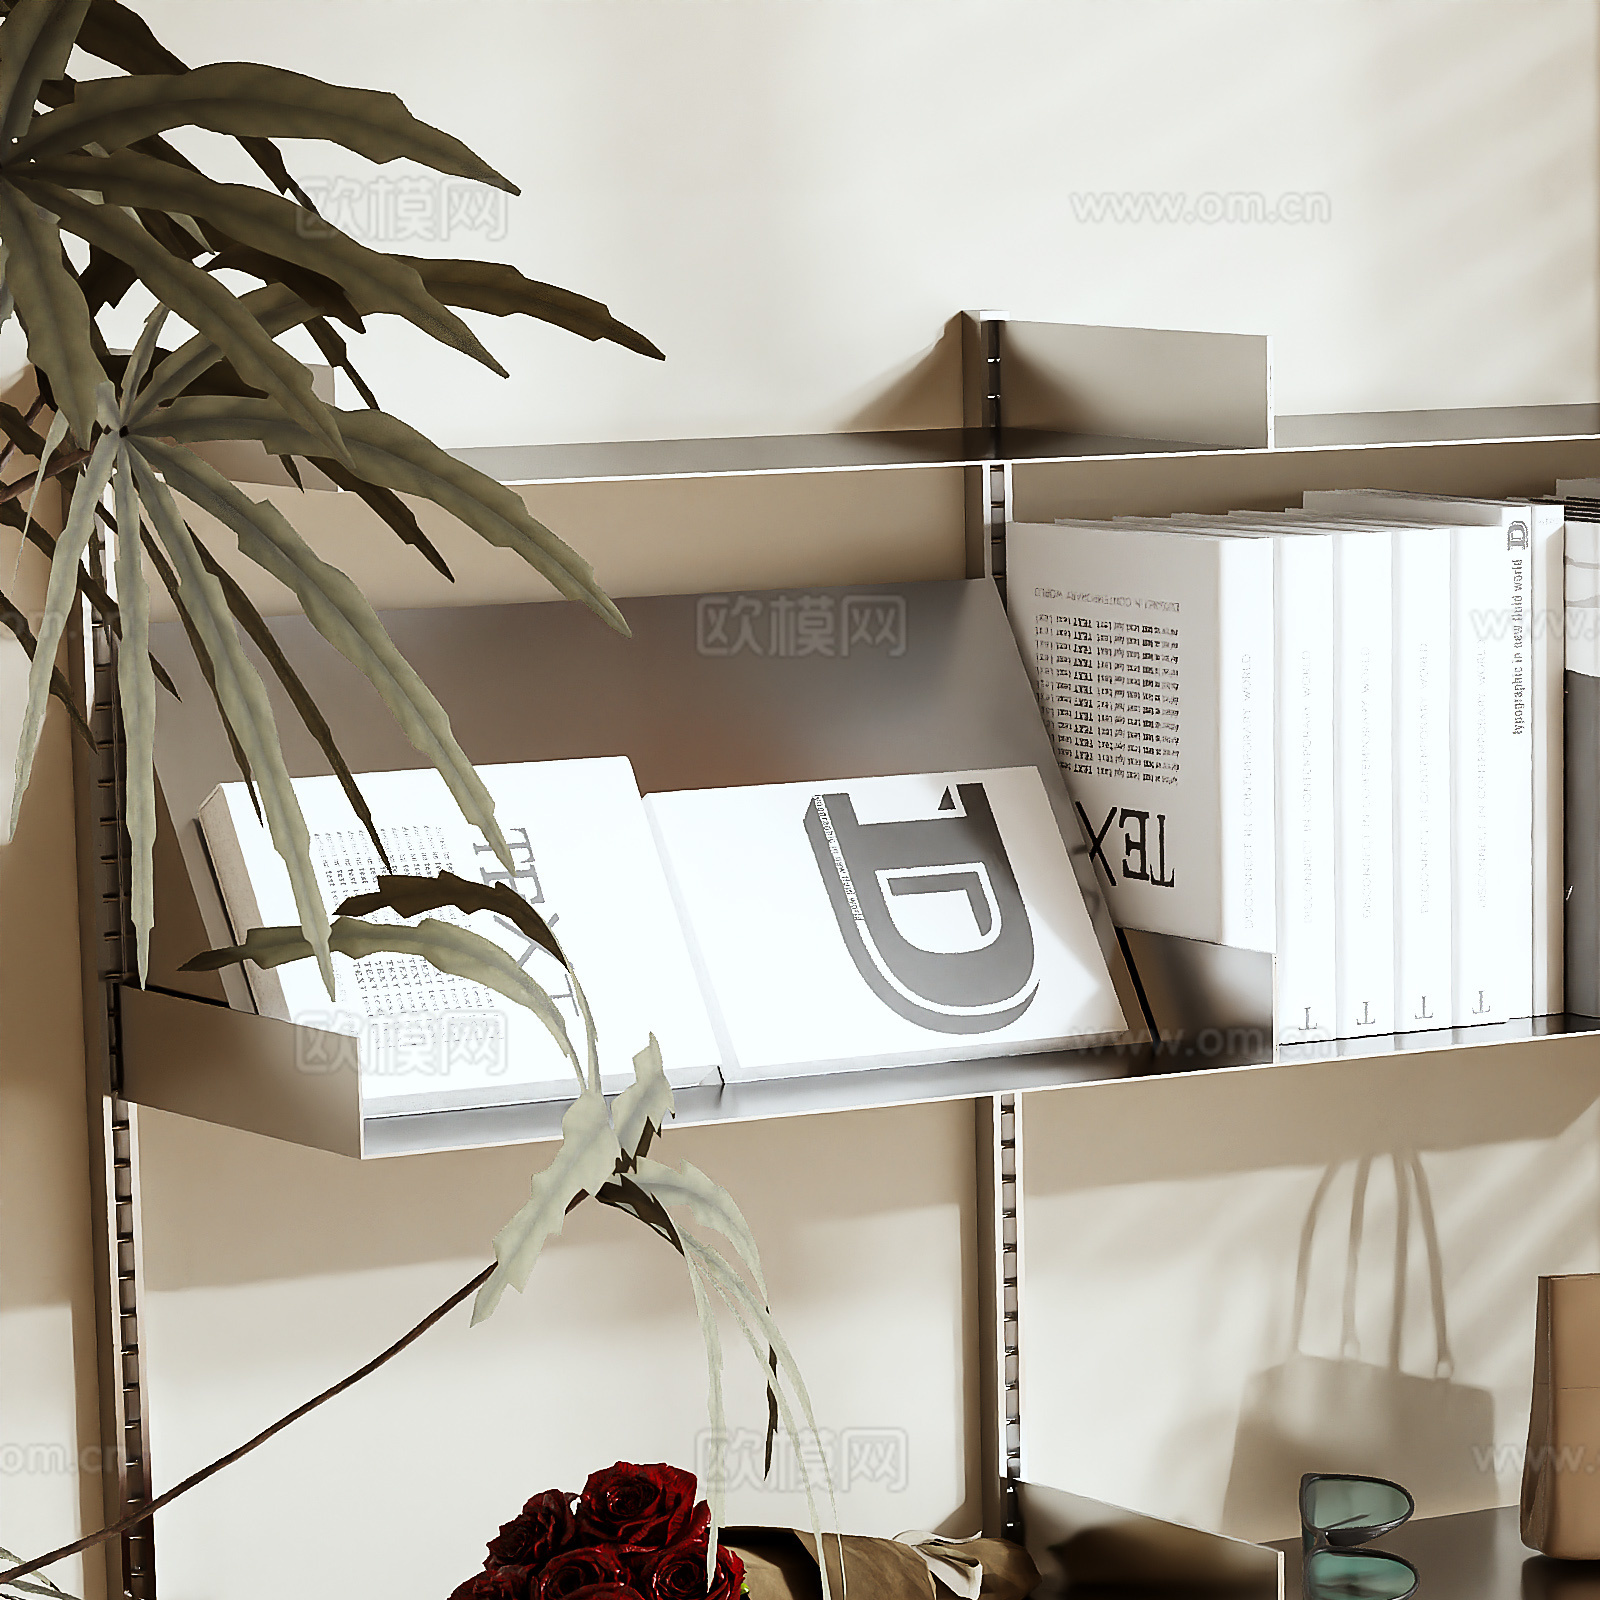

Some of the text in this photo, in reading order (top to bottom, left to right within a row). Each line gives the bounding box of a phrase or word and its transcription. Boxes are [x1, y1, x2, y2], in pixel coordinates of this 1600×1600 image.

[1511, 559, 1523, 591] world
[1512, 653, 1523, 662] in
[1512, 667, 1525, 734] typographic
[1356, 1002, 1375, 1024] T
[1415, 996, 1433, 1019] T
[1472, 991, 1490, 1013] T
[1298, 1007, 1317, 1030] T
